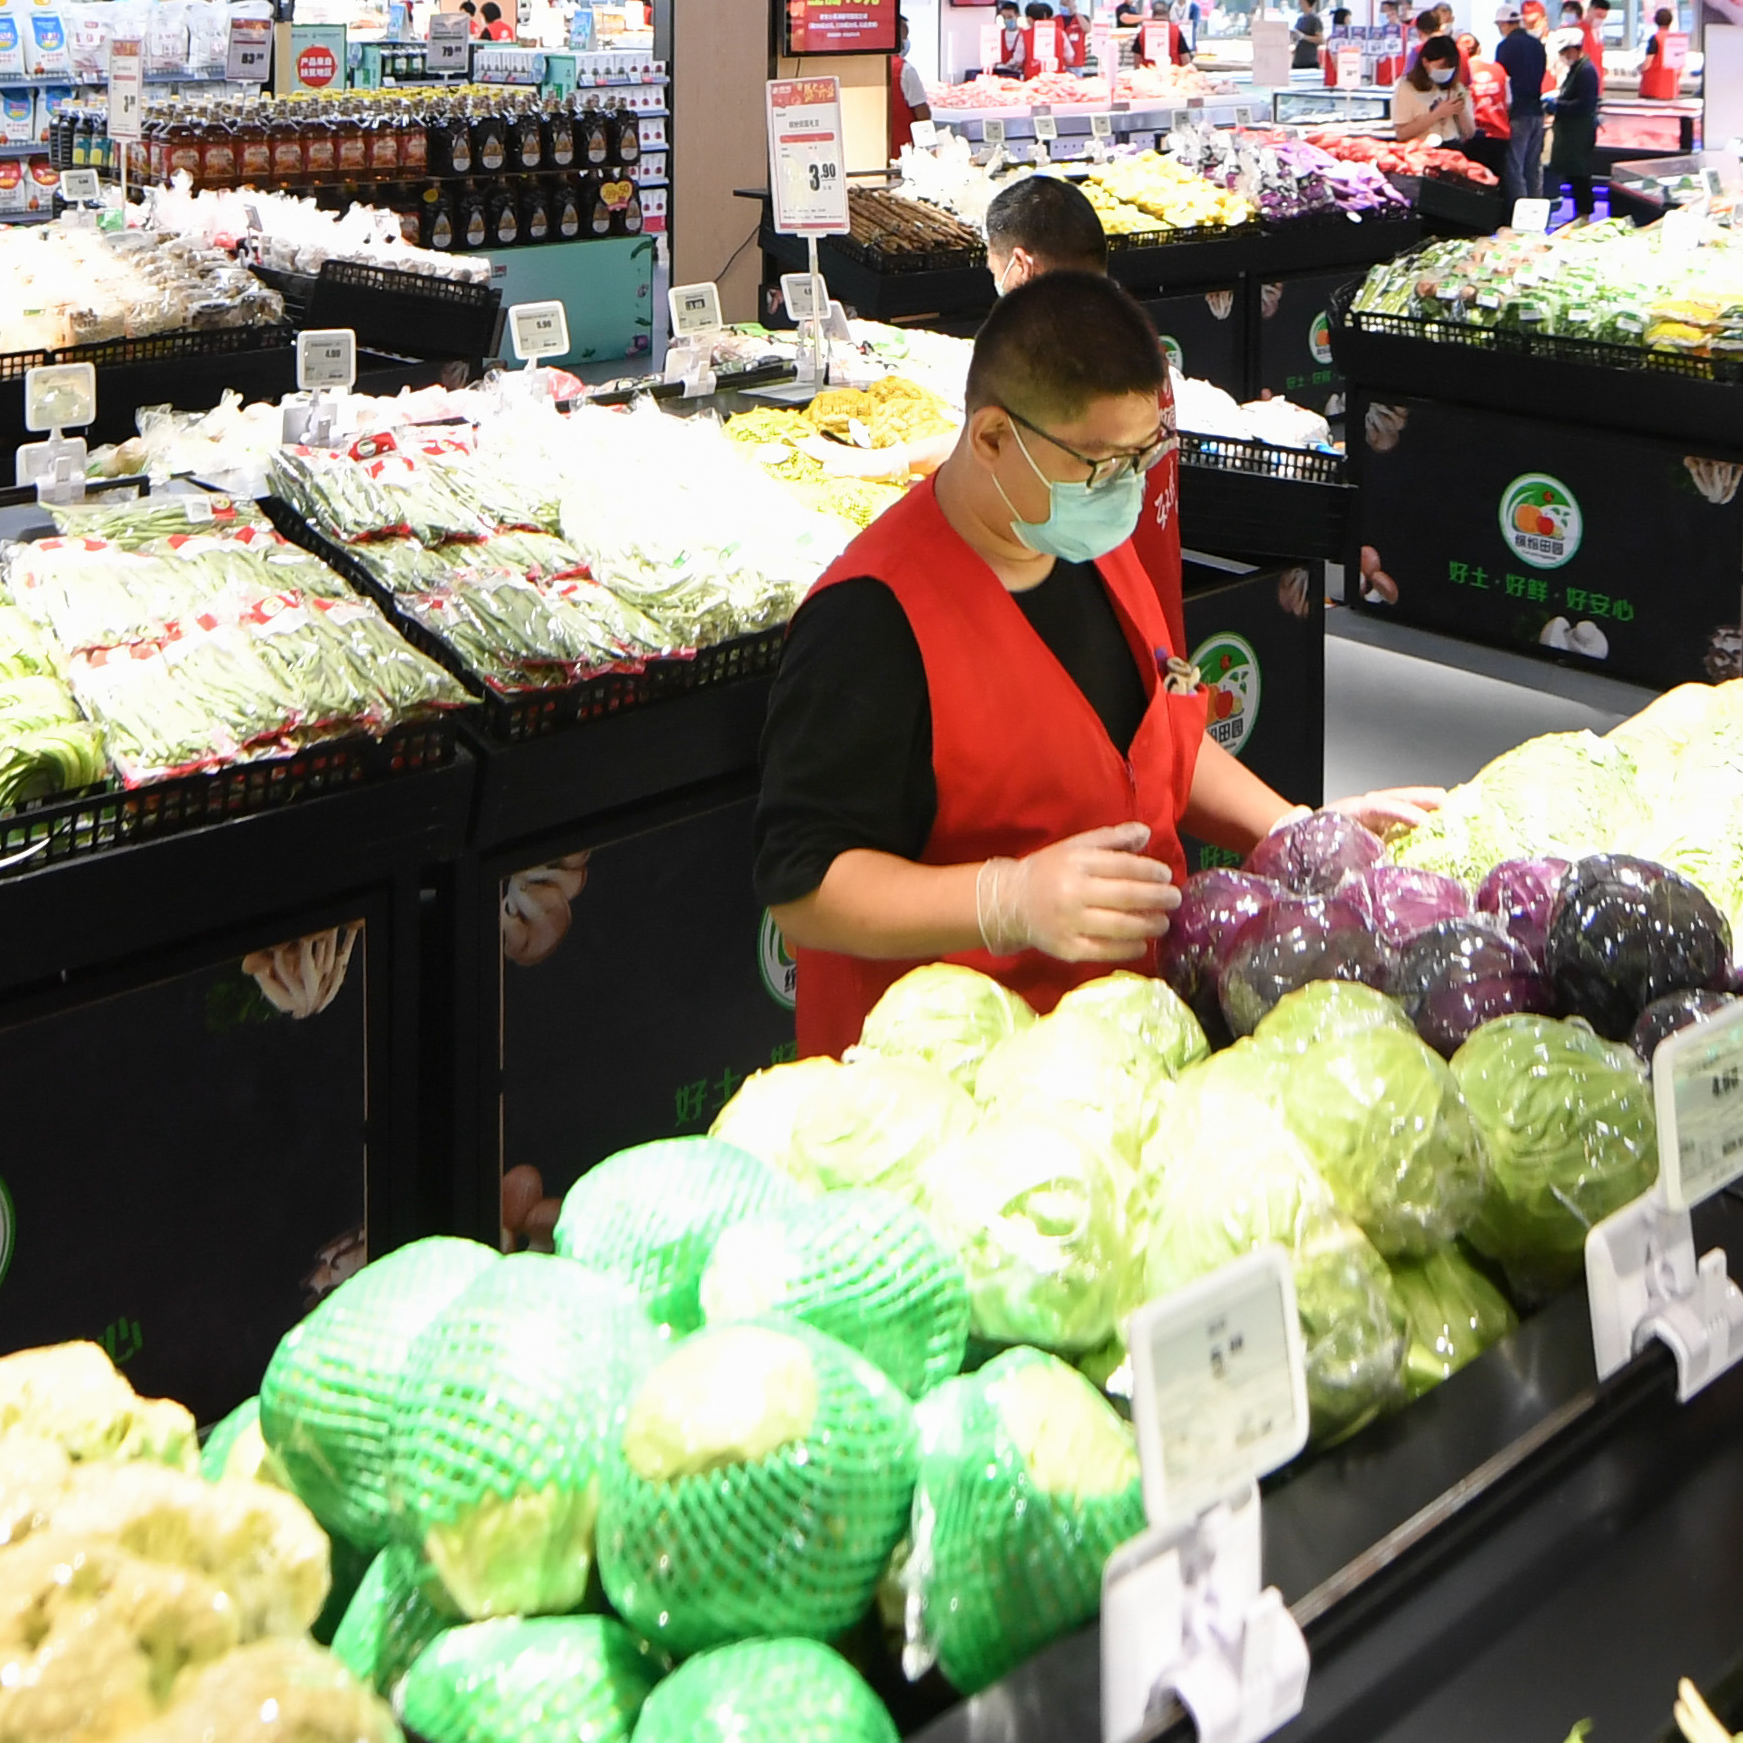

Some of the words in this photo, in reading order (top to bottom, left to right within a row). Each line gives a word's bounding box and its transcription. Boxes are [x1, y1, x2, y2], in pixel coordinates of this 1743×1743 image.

[808, 163, 836, 192] 3.90
[1514, 533, 1564, 556] 缤纷田园
[1449, 561, 1634, 622] 好土·好鲜·好安心
